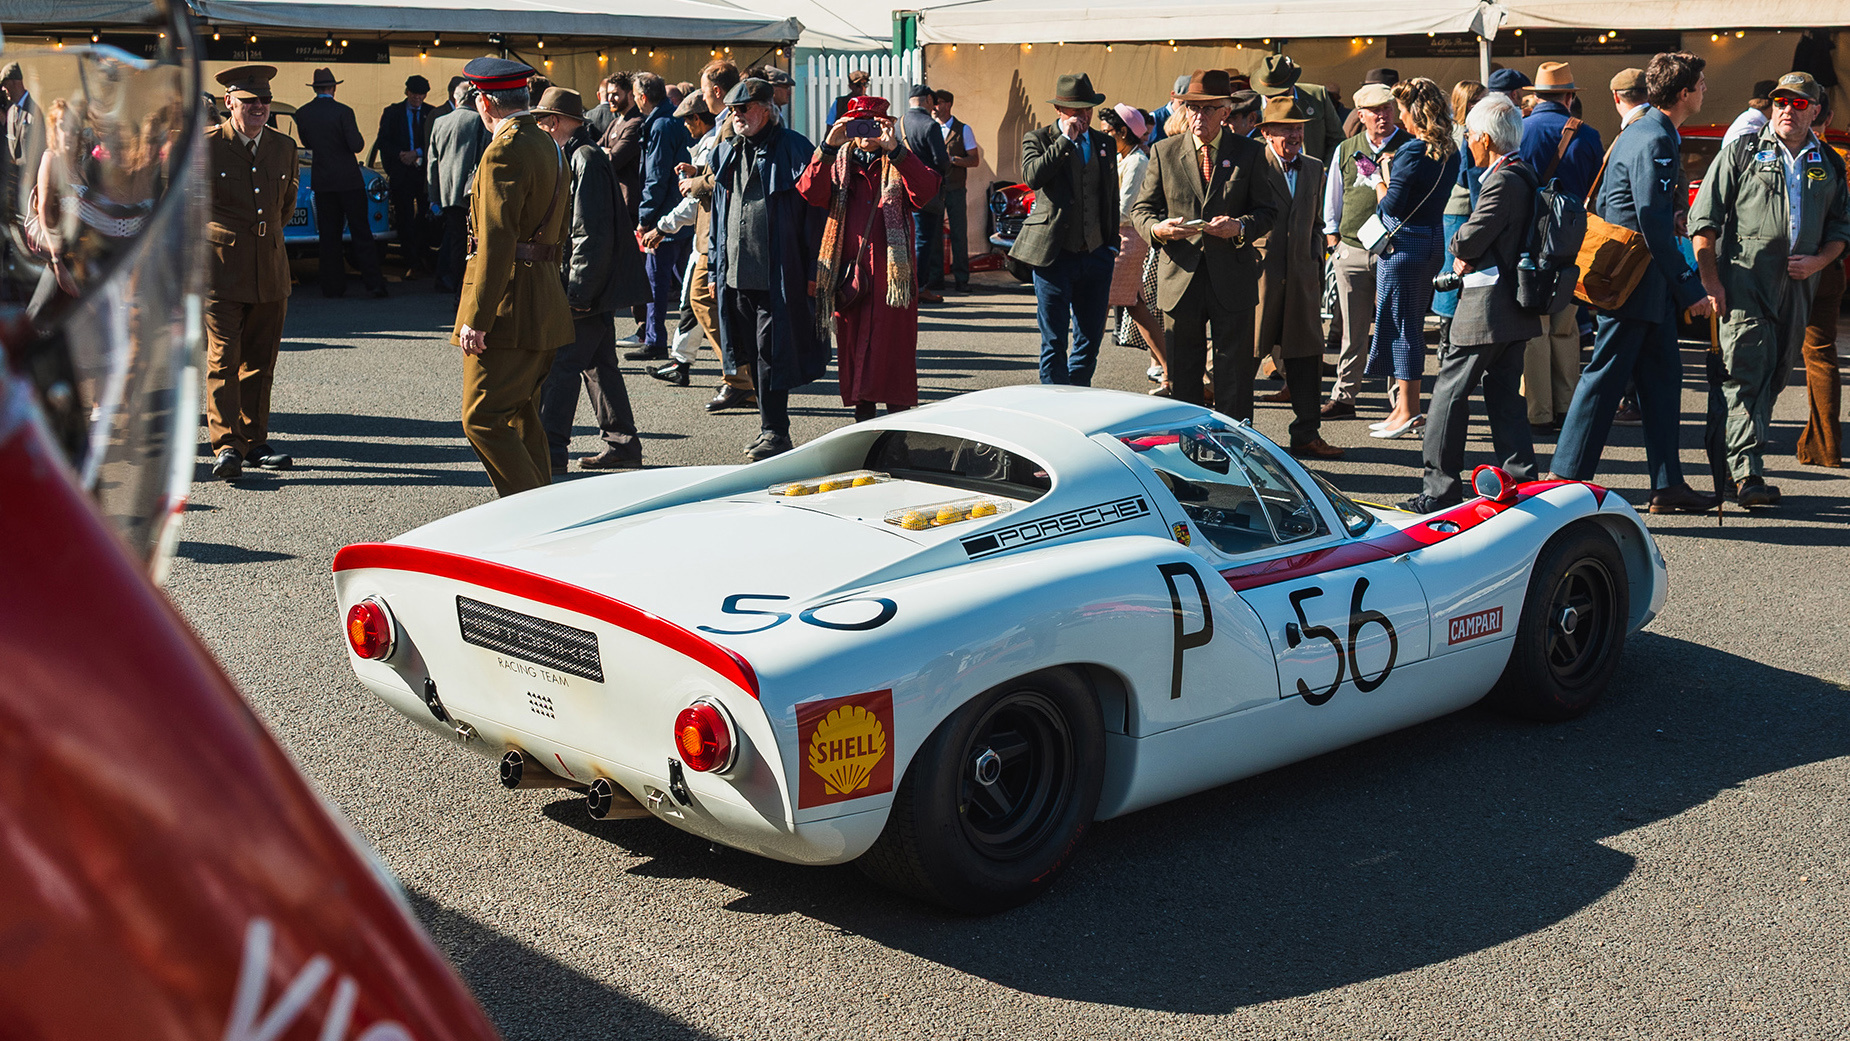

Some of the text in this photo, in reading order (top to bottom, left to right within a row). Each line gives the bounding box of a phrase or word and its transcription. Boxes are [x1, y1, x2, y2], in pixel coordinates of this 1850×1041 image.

[997, 500, 1139, 546] PORSCHE
[1156, 561, 1214, 700] P
[1289, 576, 1398, 706] 56
[1451, 610, 1501, 641] CAMPARI
[497, 657, 570, 687] RACING TEAM
[817, 734, 878, 764] SHELL
